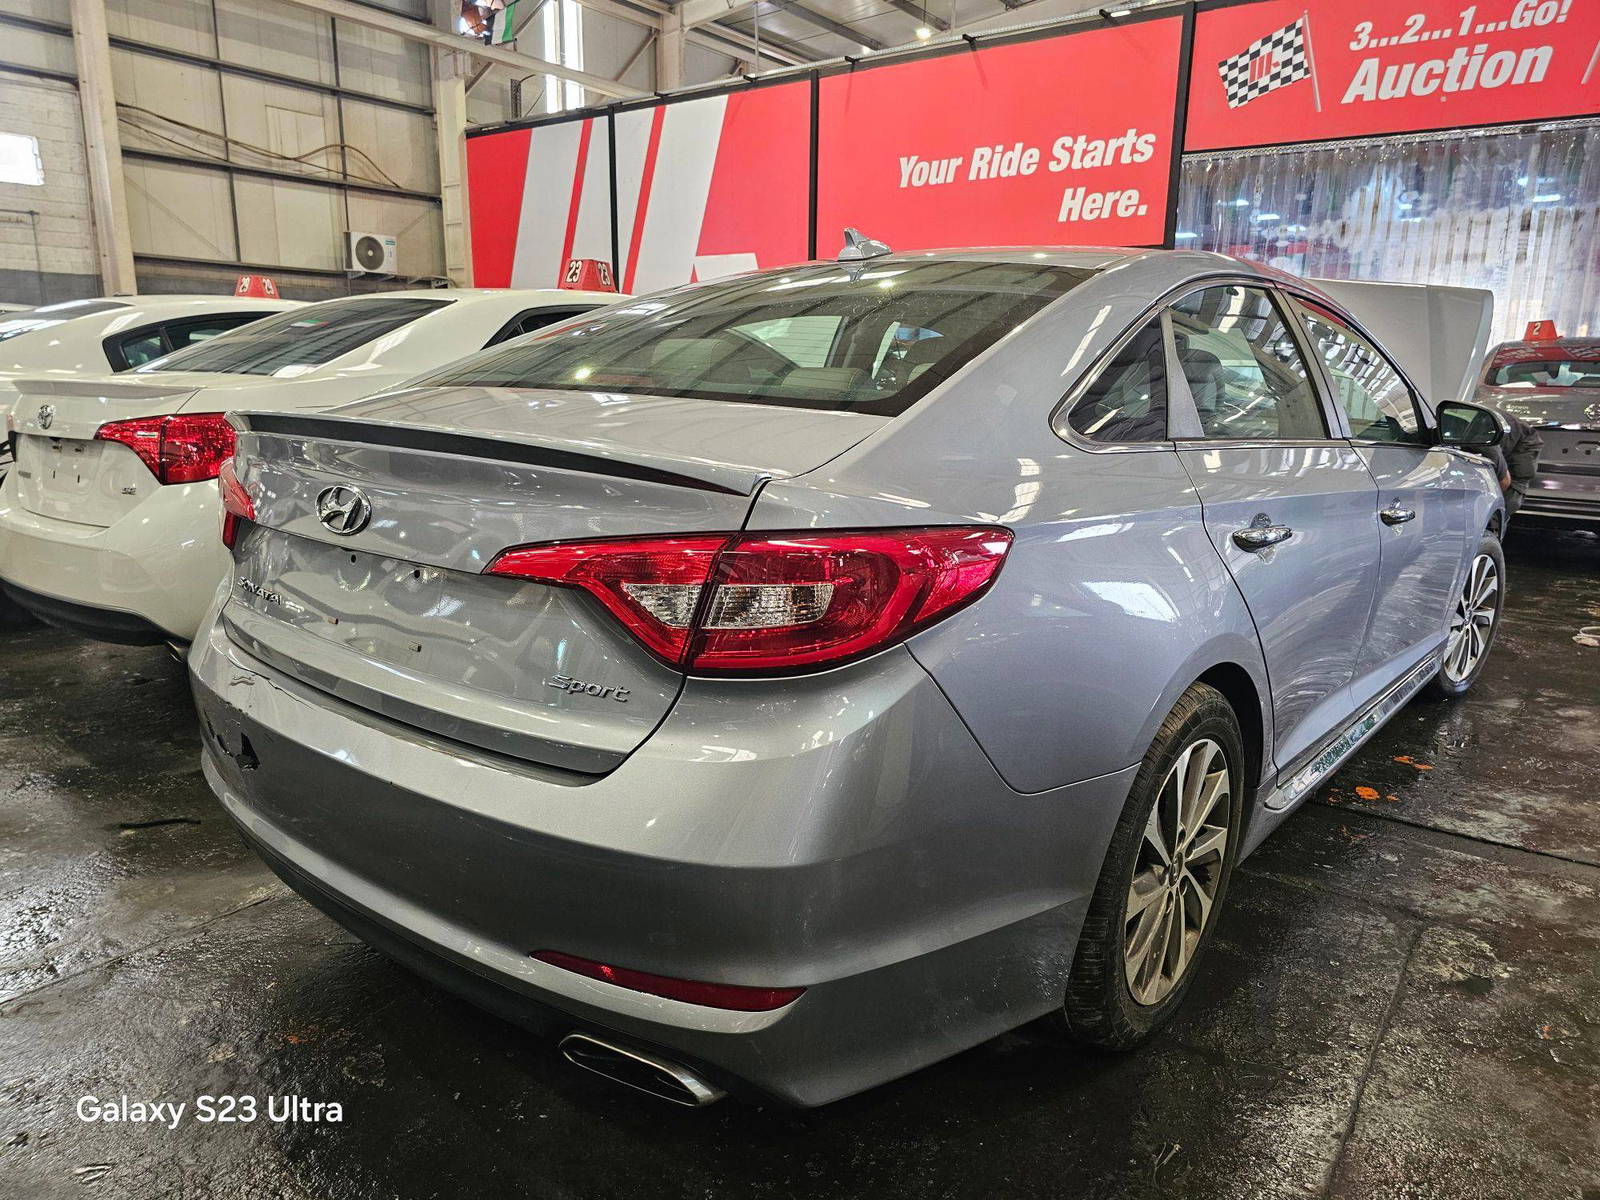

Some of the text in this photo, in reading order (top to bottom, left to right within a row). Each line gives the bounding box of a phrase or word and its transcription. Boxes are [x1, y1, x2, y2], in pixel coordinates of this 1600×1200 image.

[1340, 44, 1554, 104] Auction
[899, 128, 1157, 188] Your Ride Starts
[1057, 186, 1148, 223] Here.
[566, 260, 583, 283] 23
[1532, 322, 1542, 336] 2
[548, 674, 631, 703] Sport
